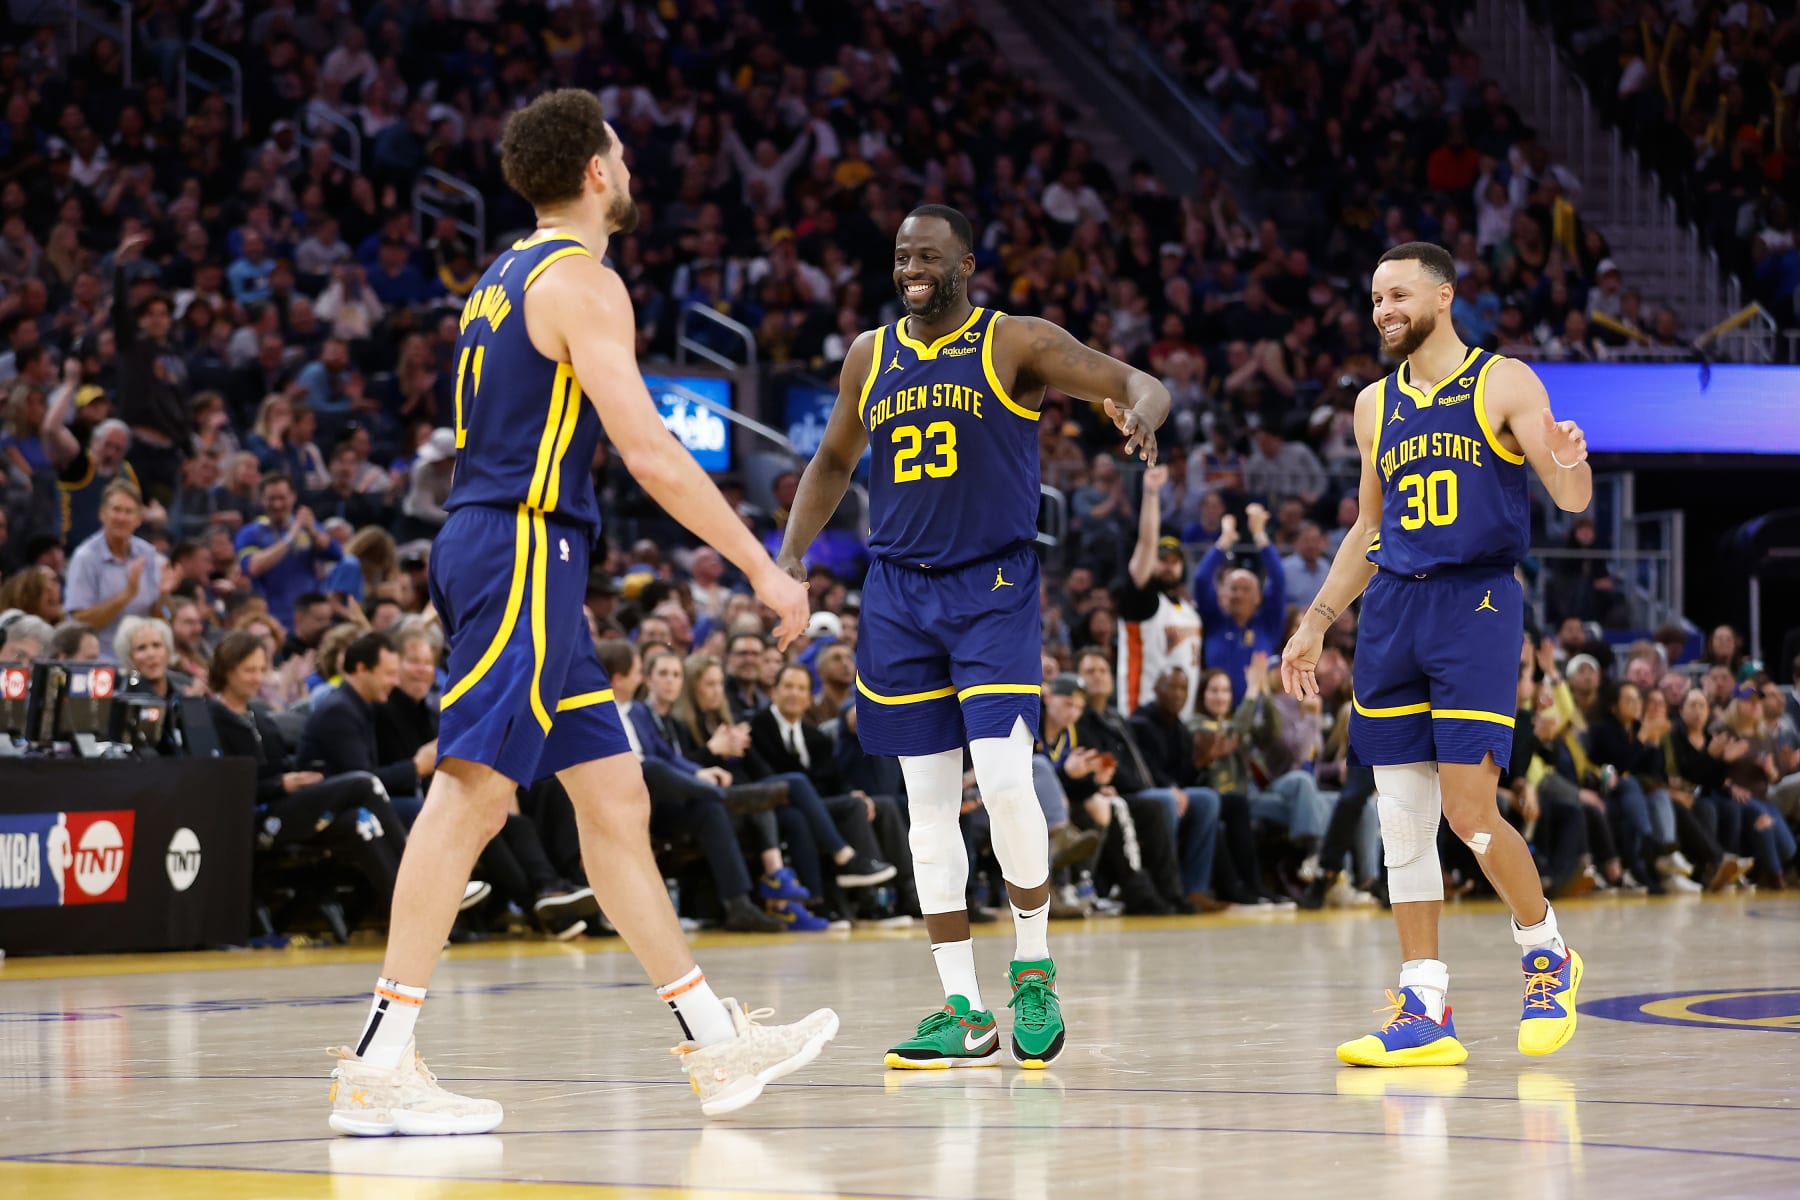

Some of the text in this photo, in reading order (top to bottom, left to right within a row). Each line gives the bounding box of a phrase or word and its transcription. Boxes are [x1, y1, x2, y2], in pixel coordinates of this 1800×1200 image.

[942, 346, 977, 357] Rakuten
[869, 383, 984, 432] GOLDEN STATE
[1438, 393, 1470, 406] Rakuten
[891, 420, 958, 483] 23
[1380, 432, 1483, 483] GOLDEN STATE
[1398, 469, 1458, 530] 30
[0, 832, 41, 889] NBA
